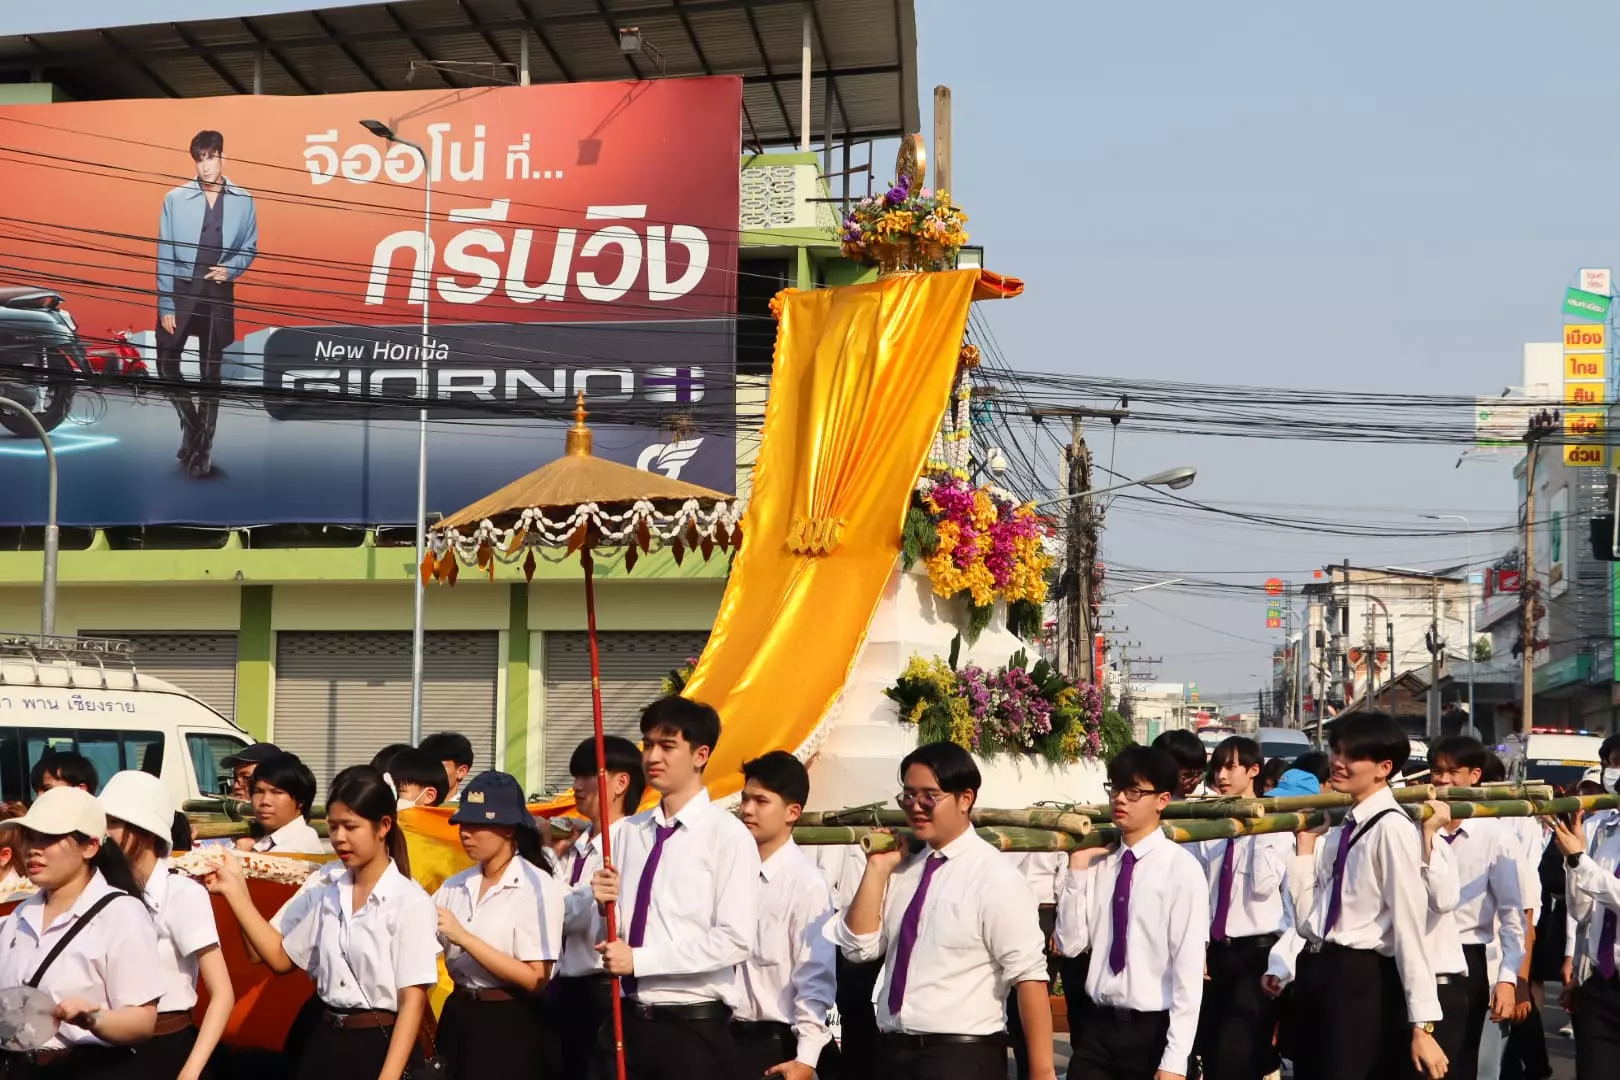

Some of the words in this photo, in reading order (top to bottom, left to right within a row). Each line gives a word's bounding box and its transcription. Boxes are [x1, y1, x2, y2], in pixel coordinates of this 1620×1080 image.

[302, 123, 486, 186] จีออโน่
[364, 198, 711, 305] กรีนวิง
[1566, 328, 1602, 345] เมือง
[314, 340, 364, 361] New
[372, 339, 450, 361] Honda
[1569, 357, 1598, 375] ไทย
[1569, 446, 1601, 462] ด่วน
[23, 698, 60, 711] พาน
[67, 694, 136, 714] เชียงราย
